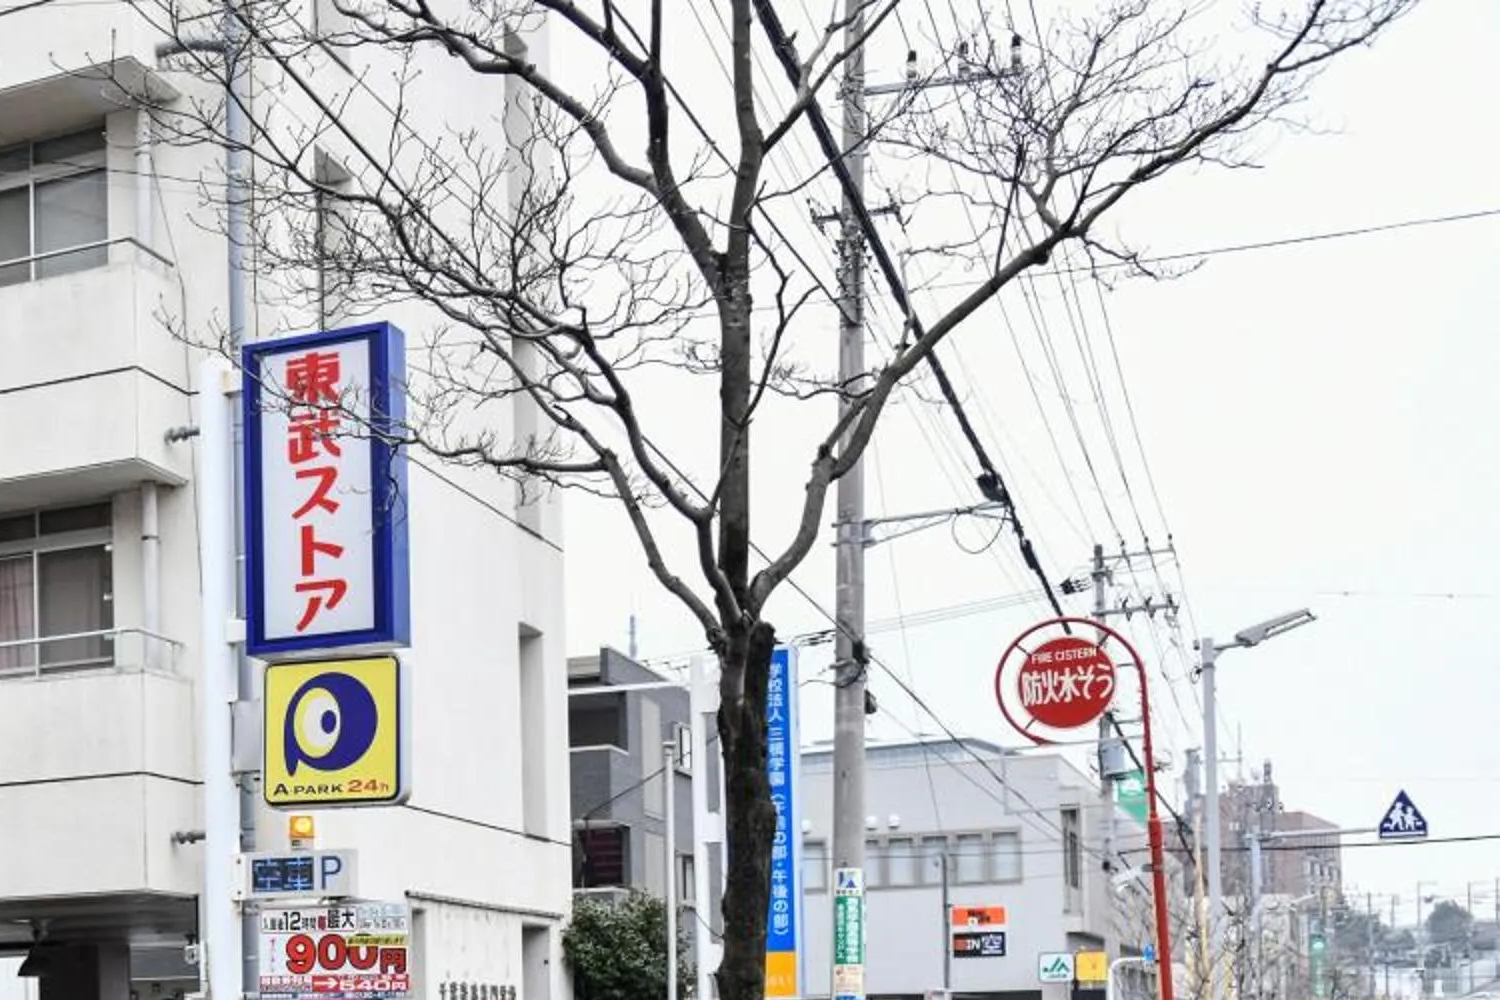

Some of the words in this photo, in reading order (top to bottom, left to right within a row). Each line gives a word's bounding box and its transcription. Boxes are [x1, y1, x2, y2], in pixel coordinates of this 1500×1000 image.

[285, 351, 348, 632] 東武ストア
[1031, 651, 1053, 665] FIRE
[1055, 647, 1097, 661] CISTERN
[1021, 663, 1114, 706] 防火水そう
[293, 783, 343, 795] PARK
[321, 855, 342, 890] P
[285, 932, 407, 975] 900円
